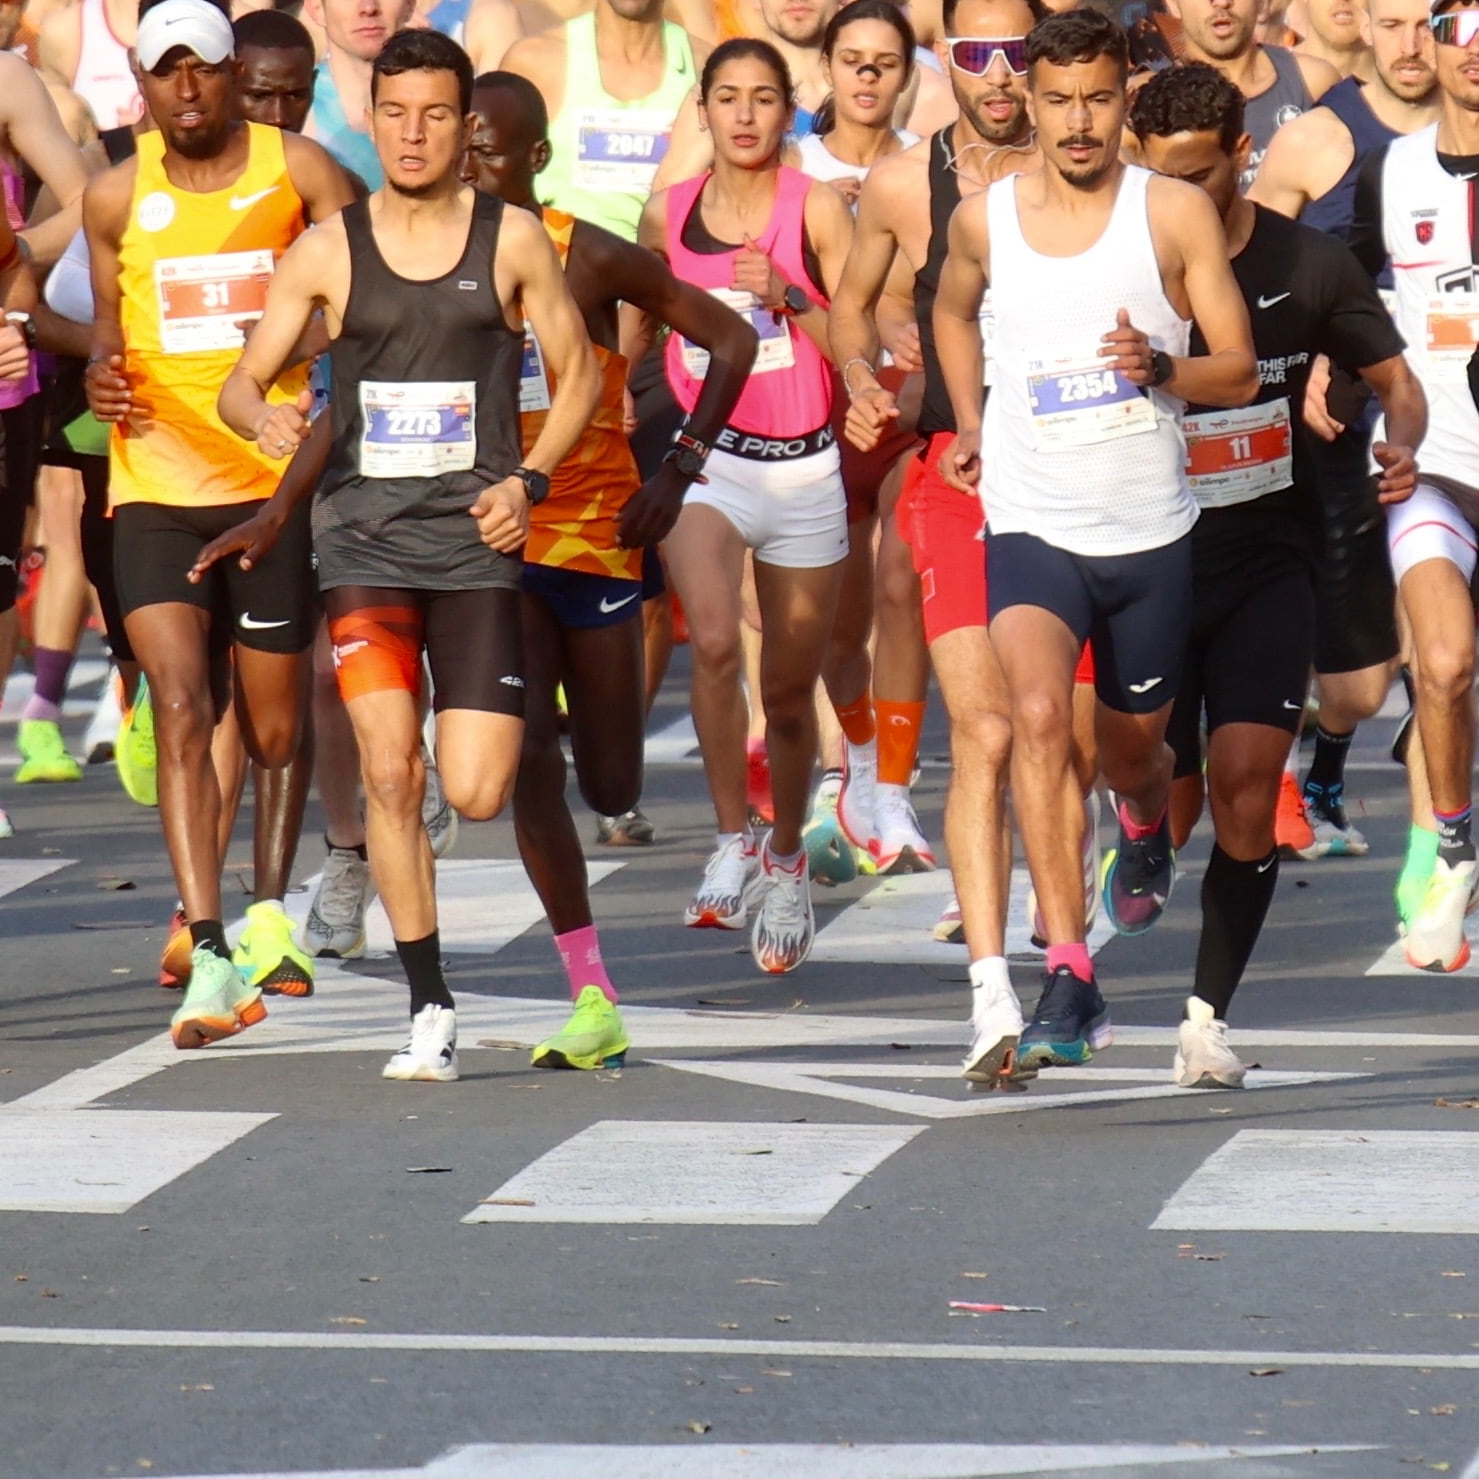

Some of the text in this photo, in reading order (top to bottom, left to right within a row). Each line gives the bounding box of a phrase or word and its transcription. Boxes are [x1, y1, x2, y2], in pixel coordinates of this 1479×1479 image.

[607, 133, 655, 156] 2047
[202, 282, 229, 308] 31
[1057, 370, 1118, 404] 2354
[1259, 371, 1287, 385] FAR
[387, 410, 442, 437] 2273
[740, 437, 807, 458] PRO
[1229, 435, 1252, 460] 11
